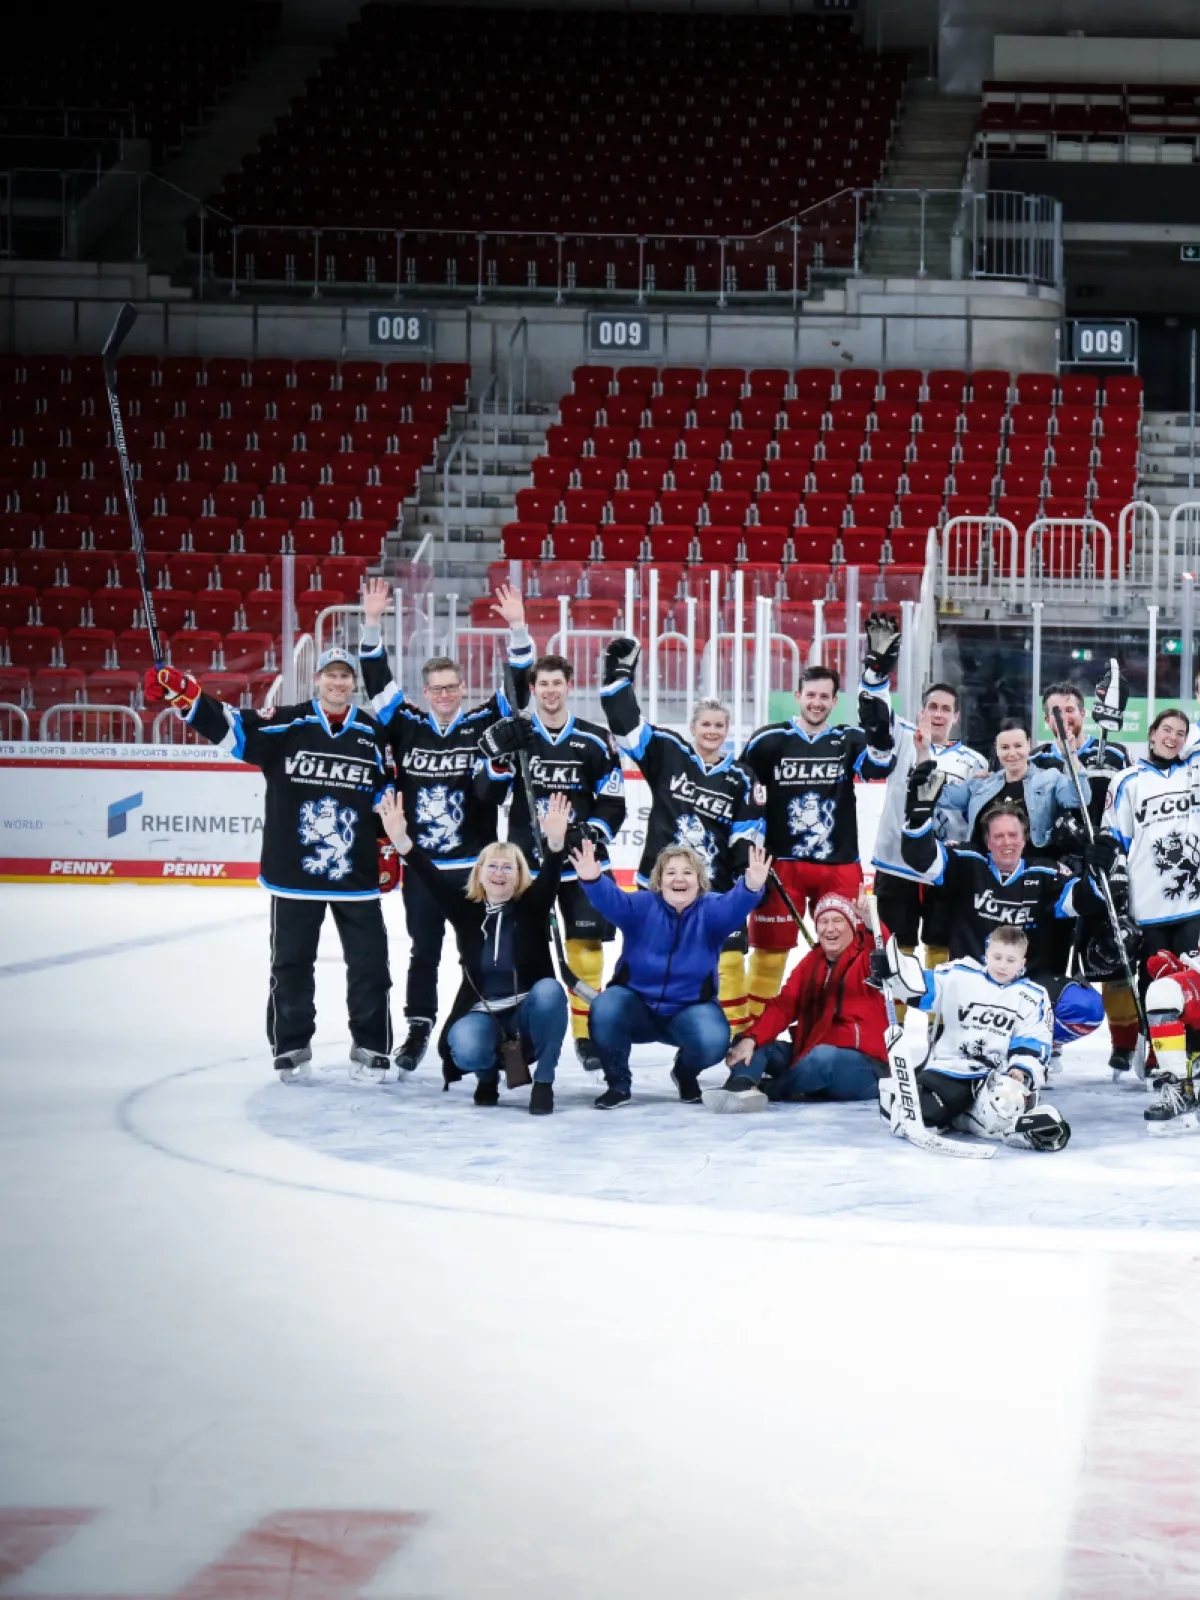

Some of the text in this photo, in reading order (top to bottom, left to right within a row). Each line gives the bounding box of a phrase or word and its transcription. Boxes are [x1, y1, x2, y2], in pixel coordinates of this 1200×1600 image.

[377, 316, 420, 340] 008
[599, 321, 642, 346] 009
[1080, 329, 1123, 353] 009
[285, 755, 373, 785] VÖLKEL
[2, 819, 43, 830] WORLD
[141, 815, 263, 834] RHEINMETA
[893, 1055, 917, 1122] BAUER
